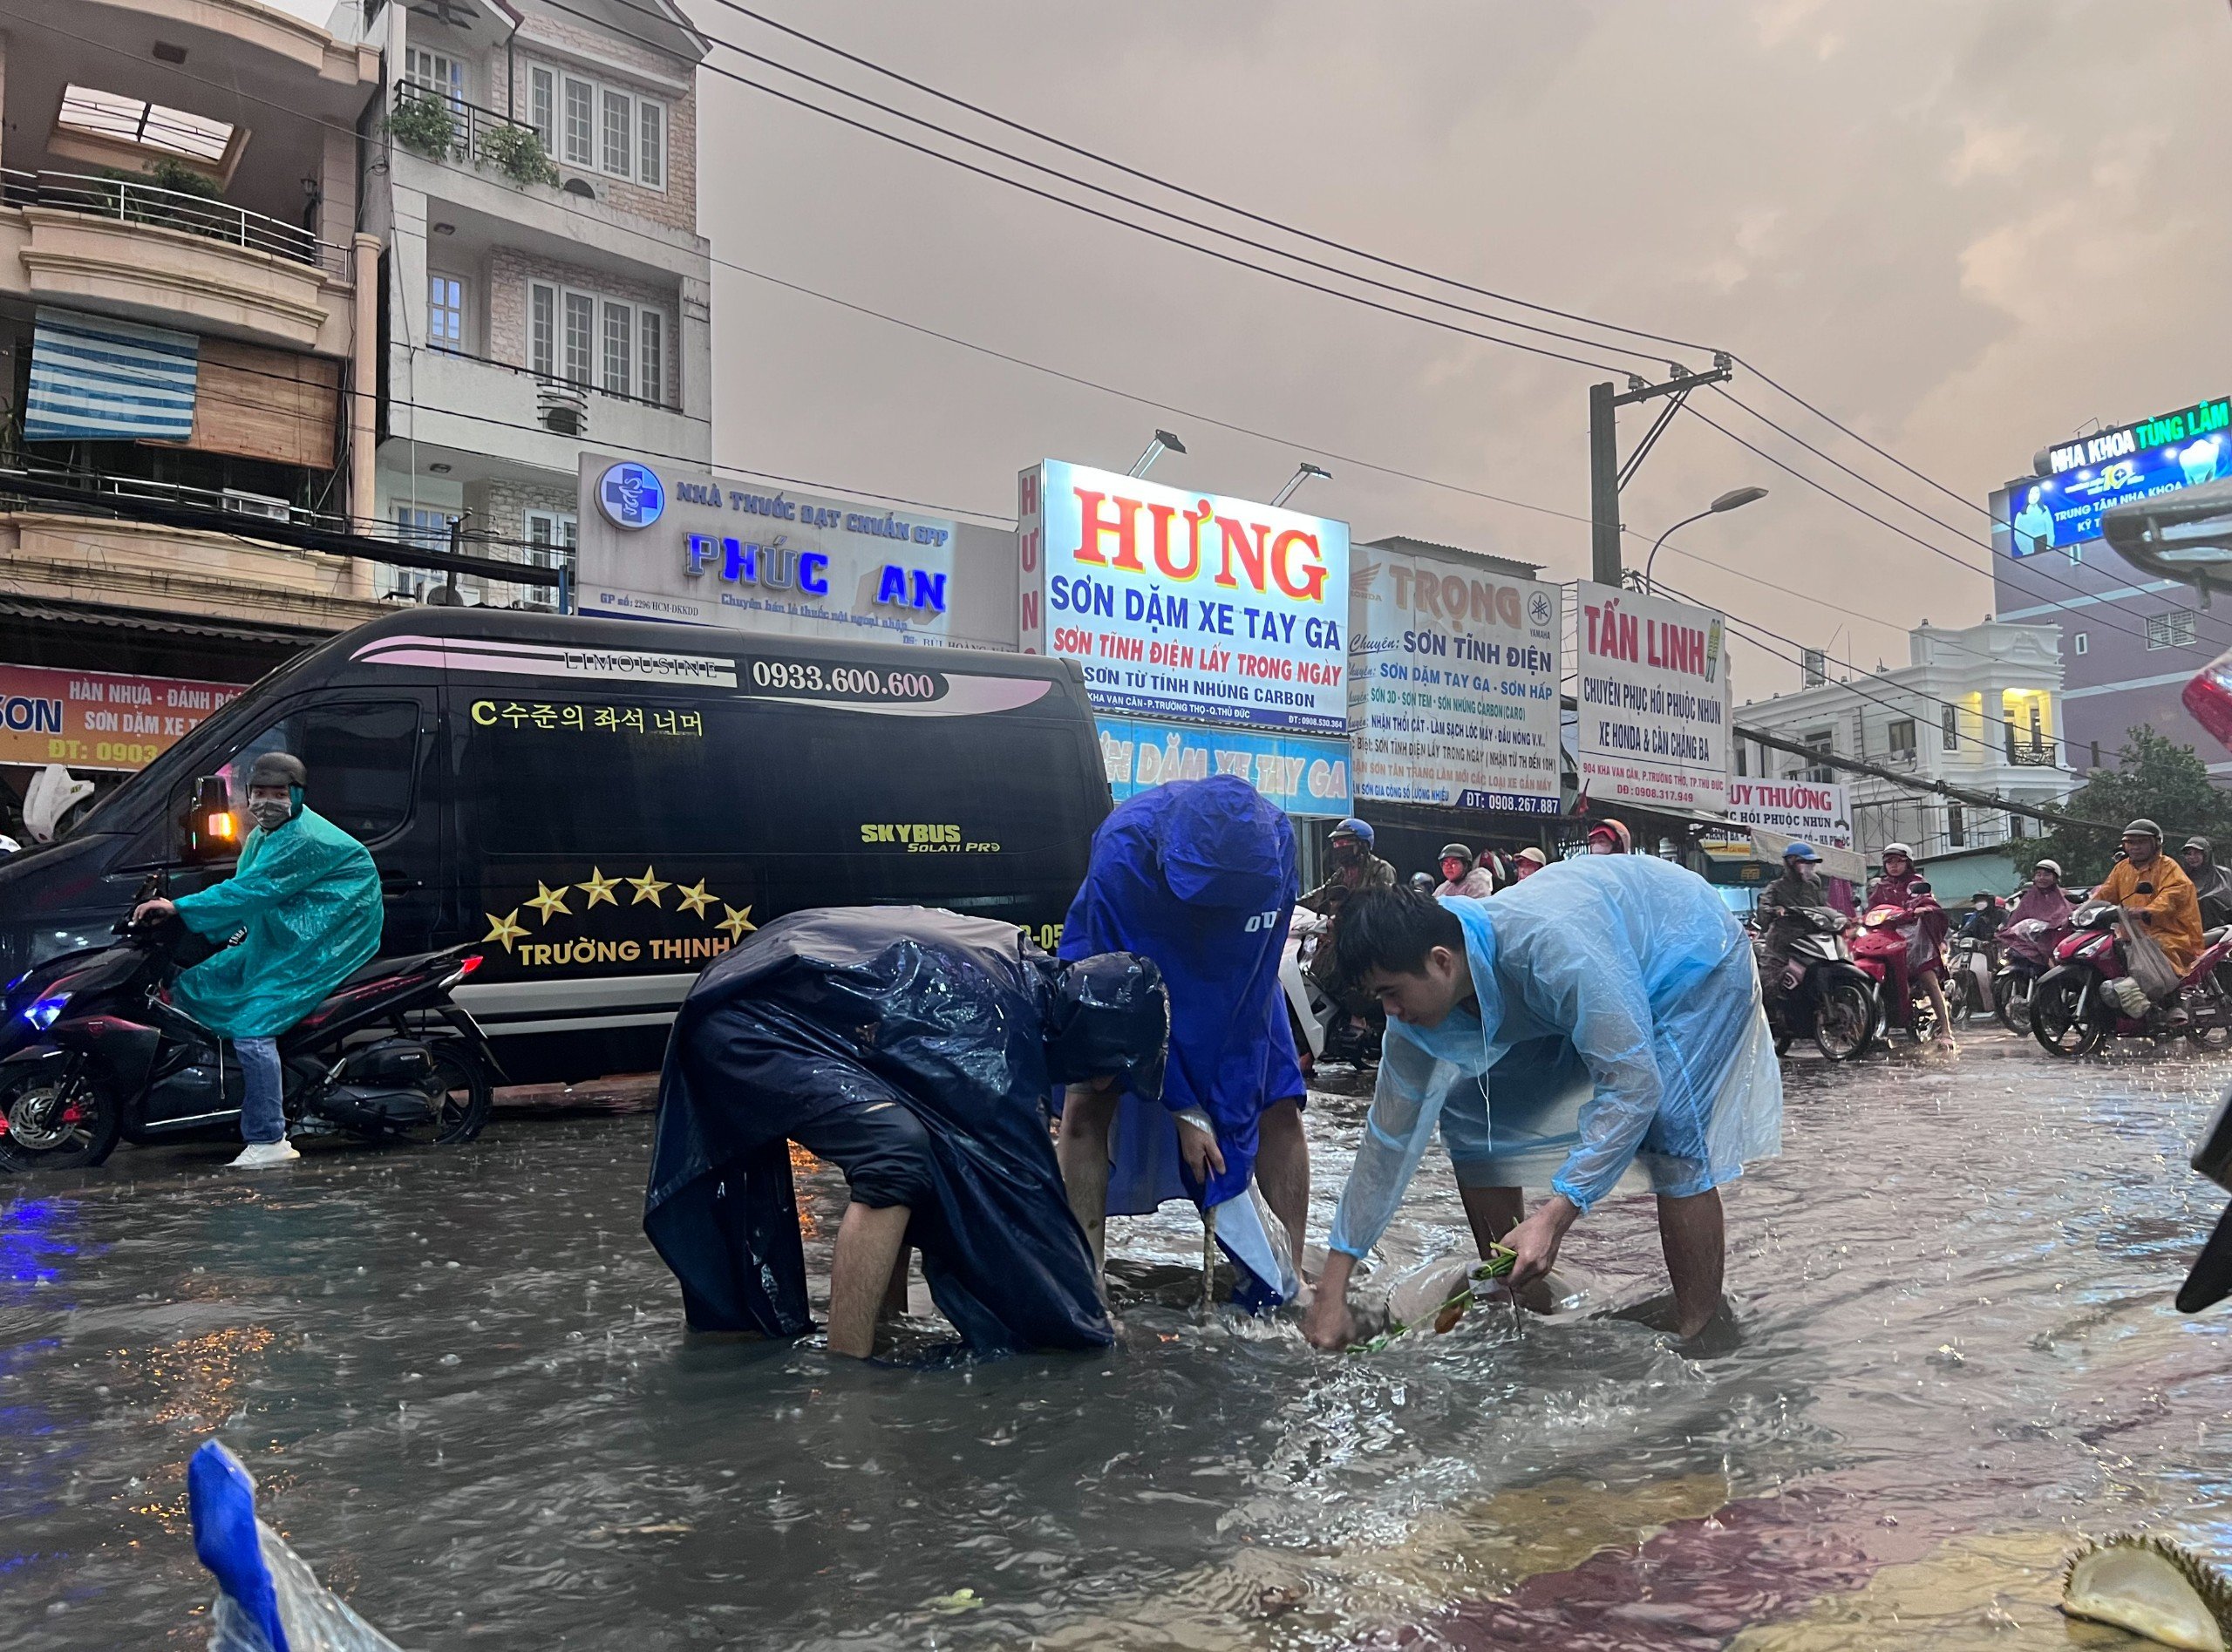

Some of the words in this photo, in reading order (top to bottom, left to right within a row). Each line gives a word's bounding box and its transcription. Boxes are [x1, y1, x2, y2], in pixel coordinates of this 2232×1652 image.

[2050, 444, 2086, 473] NHA
[2088, 430, 2136, 464] KHOA
[2187, 400, 2229, 435] LÂM
[677, 482, 722, 507] NHÀ
[729, 492, 795, 520] THUỐC
[912, 526, 949, 547] GPP
[2054, 505, 2092, 521] TRUNG
[2093, 497, 2117, 512] TÂM
[2120, 490, 2145, 504] NHA
[2147, 480, 2183, 498] KHOA
[1072, 486, 1329, 603] HƯNG
[685, 533, 828, 596] PHÚC
[874, 564, 947, 612] AN
[1022, 474, 1039, 654] HƯN
[600, 593, 615, 604] GP
[721, 593, 762, 610] Chuyên
[1051, 574, 1113, 617] SƠN
[1126, 584, 1188, 634] DẶM
[1198, 600, 1235, 636] XE
[1244, 608, 1297, 644] TAY
[1305, 616, 1341, 651] GA
[1389, 563, 1522, 633] TRỌNG
[1529, 628, 1551, 641] YAMAHA
[1584, 597, 1639, 663] TẤN
[1647, 619, 1705, 677] LINH
[564, 652, 718, 678] LIMOUSINE
[1053, 624, 1092, 655] SƠN
[1099, 630, 1144, 662] TĨNH
[1149, 638, 1194, 672] ĐIỆN
[1200, 642, 1231, 674] LẤY
[1237, 653, 1294, 682] TRONG
[1298, 657, 1343, 687] NGÀY
[1349, 633, 1400, 653] Chuyên:
[1403, 629, 1446, 656] SƠN
[1453, 632, 1500, 665] TĨNH
[1506, 644, 1552, 676] ĐIỆN
[69, 677, 103, 702] HÀN
[109, 683, 153, 709] NHỰA
[167, 685, 210, 710] ĐÁNH
[752, 660, 936, 698] 0933.600.600
[1084, 666, 1119, 685] SƠN
[1126, 670, 1148, 688] TỪ
[1151, 672, 1188, 694] TÍNH
[1194, 679, 1249, 701] NHÚNG
[1254, 688, 1315, 708] CARBON
[1380, 663, 1408, 681] SƠN
[1412, 664, 1440, 687] DẶM
[1444, 671, 1469, 689] TAY
[1473, 676, 1490, 693] GA
[1500, 680, 1526, 697] SƠN
[1530, 681, 1553, 701] HẤP
[0, 695, 62, 734] ƠN
[1106, 694, 1124, 706] VẠN
[1234, 707, 1250, 718] ĐỨC
[1371, 686, 1385, 704] SƠN
[1387, 690, 1397, 704] 3D
[1401, 690, 1417, 707] SƠN
[1418, 693, 1432, 708] TEM
[1438, 695, 1452, 710] SƠN
[1453, 696, 1476, 714] NHÚNG
[1583, 676, 1621, 707] CHUYÊN
[1623, 683, 1648, 717] PHỤC
[1667, 690, 1696, 724] PHUỘC
[1698, 696, 1721, 725] NHÚN
[85, 710, 119, 732] SƠN
[123, 711, 160, 737] DẶM
[164, 717, 184, 737] XE
[594, 706, 644, 734] 좌석
[653, 710, 703, 737] 너머
[1371, 713, 1391, 731] NHẬN
[1412, 715, 1426, 732] CÁT
[48, 738, 87, 760] ĐT:
[1374, 738, 1389, 753] SƠN
[1443, 745, 1465, 761] TRONG
[1519, 755, 1528, 768] 7H
[1599, 720, 1610, 747] XE
[1612, 723, 1641, 751] HONDA
[1643, 728, 1650, 752] &
[1651, 725, 1669, 756] CÂN
[1671, 725, 1697, 760] CHẢNG
[1698, 737, 1710, 762] BA
[1214, 749, 1252, 780] XE
[1255, 752, 1306, 797] TAY
[1308, 758, 1347, 799] GA
[1370, 761, 1386, 775] SƠN
[1406, 766, 1434, 779] TRANG
[1507, 778, 1518, 789] XE
[1536, 776, 1552, 792] MÁY
[1582, 762, 1596, 774] 904
[1597, 765, 1610, 776] KHA
[1361, 781, 1374, 796] SƠN
[1374, 785, 1385, 797] GIA
[1385, 784, 1402, 799] CÔNG
[1466, 791, 1485, 809] ĐT:
[1488, 794, 1559, 814] 0908.267.887
[1635, 786, 1694, 802] 0908.317.949
[1755, 783, 1832, 811] THƯỜNG
[861, 824, 961, 843] SKYBUS
[1764, 812, 1800, 828] PHUỘC
[1803, 814, 1831, 828] NHÚN
[965, 842, 1001, 853] PRO
[518, 936, 641, 966] TRƯỜNG
[649, 936, 731, 964] THỊNH
